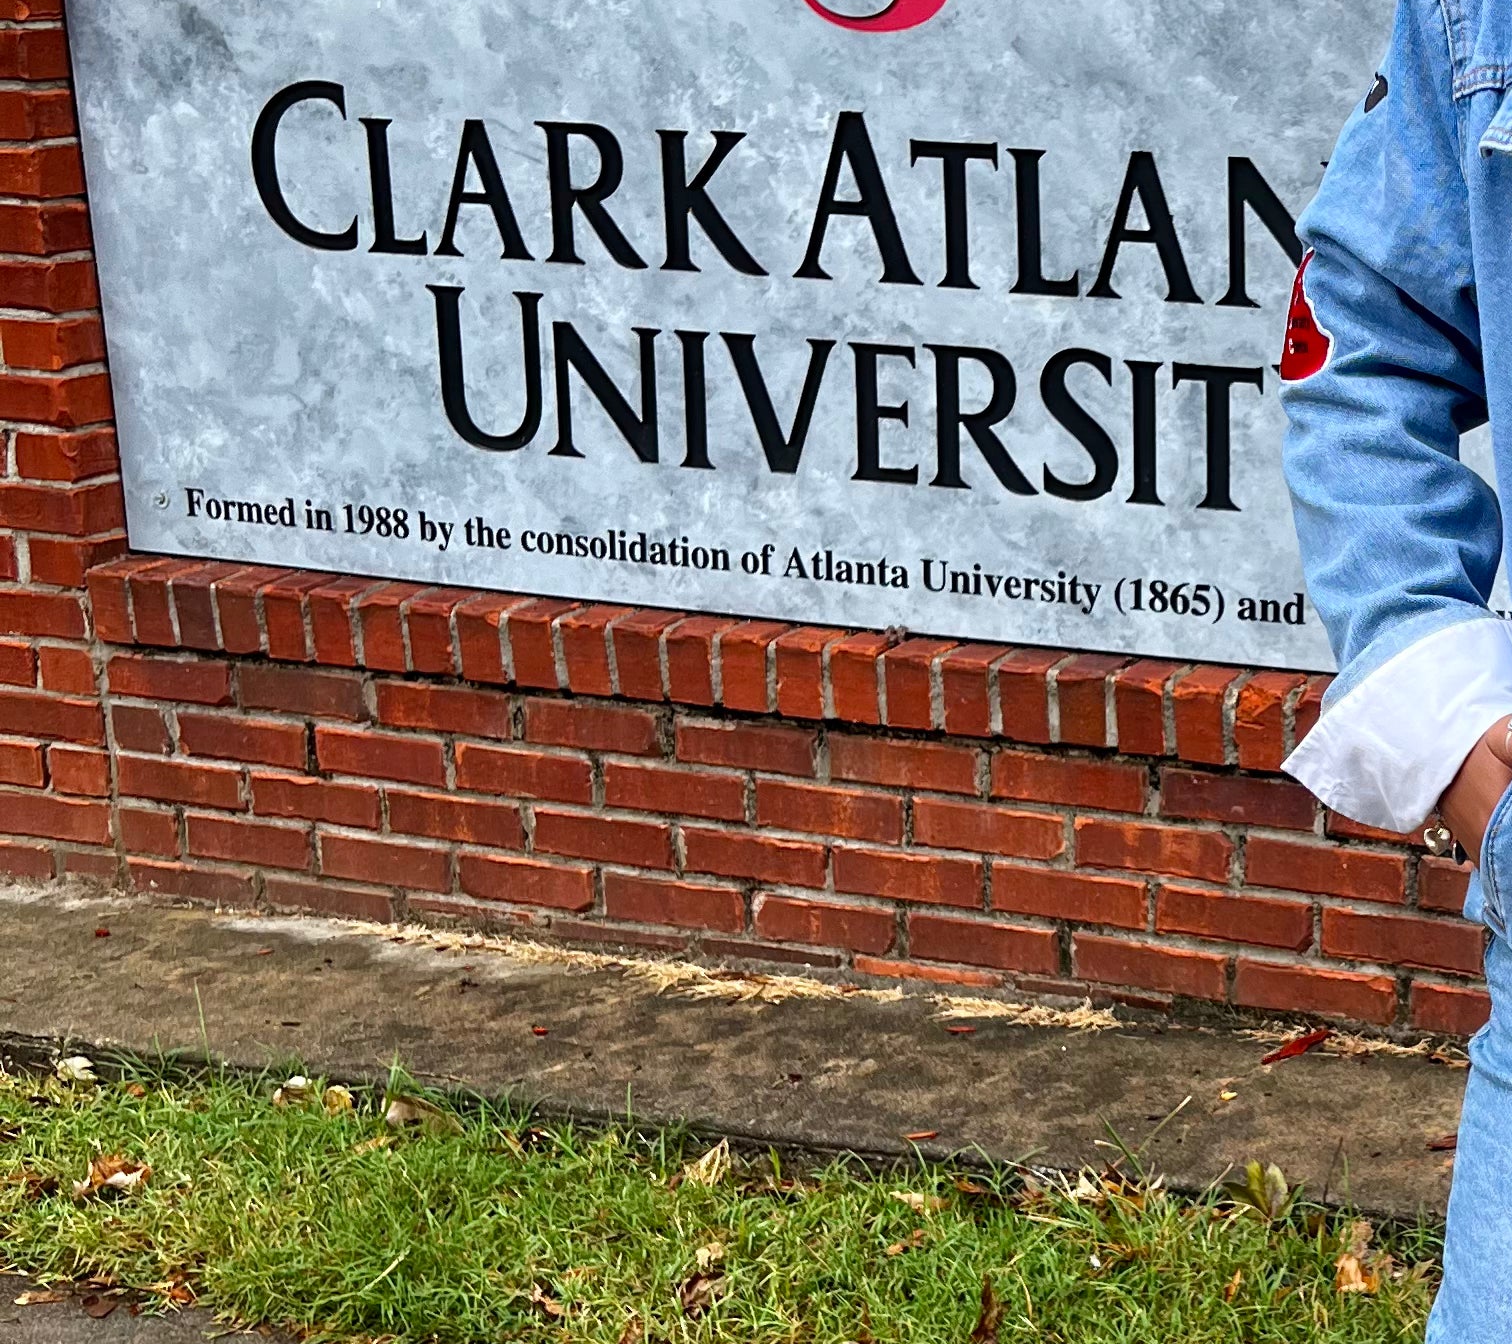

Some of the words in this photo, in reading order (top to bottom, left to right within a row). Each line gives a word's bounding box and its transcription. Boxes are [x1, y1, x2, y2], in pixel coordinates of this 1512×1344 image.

[250, 80, 770, 278] CLARK
[792, 110, 1328, 309] ATLAN
[425, 283, 1281, 513] UNIVERSIT
[185, 487, 297, 528] Formed
[305, 499, 333, 532] in
[342, 503, 410, 539] 1988
[418, 510, 455, 552] by
[463, 516, 512, 550] the
[520, 528, 730, 571] consolidation
[741, 543, 776, 575] of
[783, 546, 910, 589] Atlanta
[920, 558, 1102, 615] University
[1114, 577, 1225, 625] (1865)
[1237, 592, 1306, 626] and
